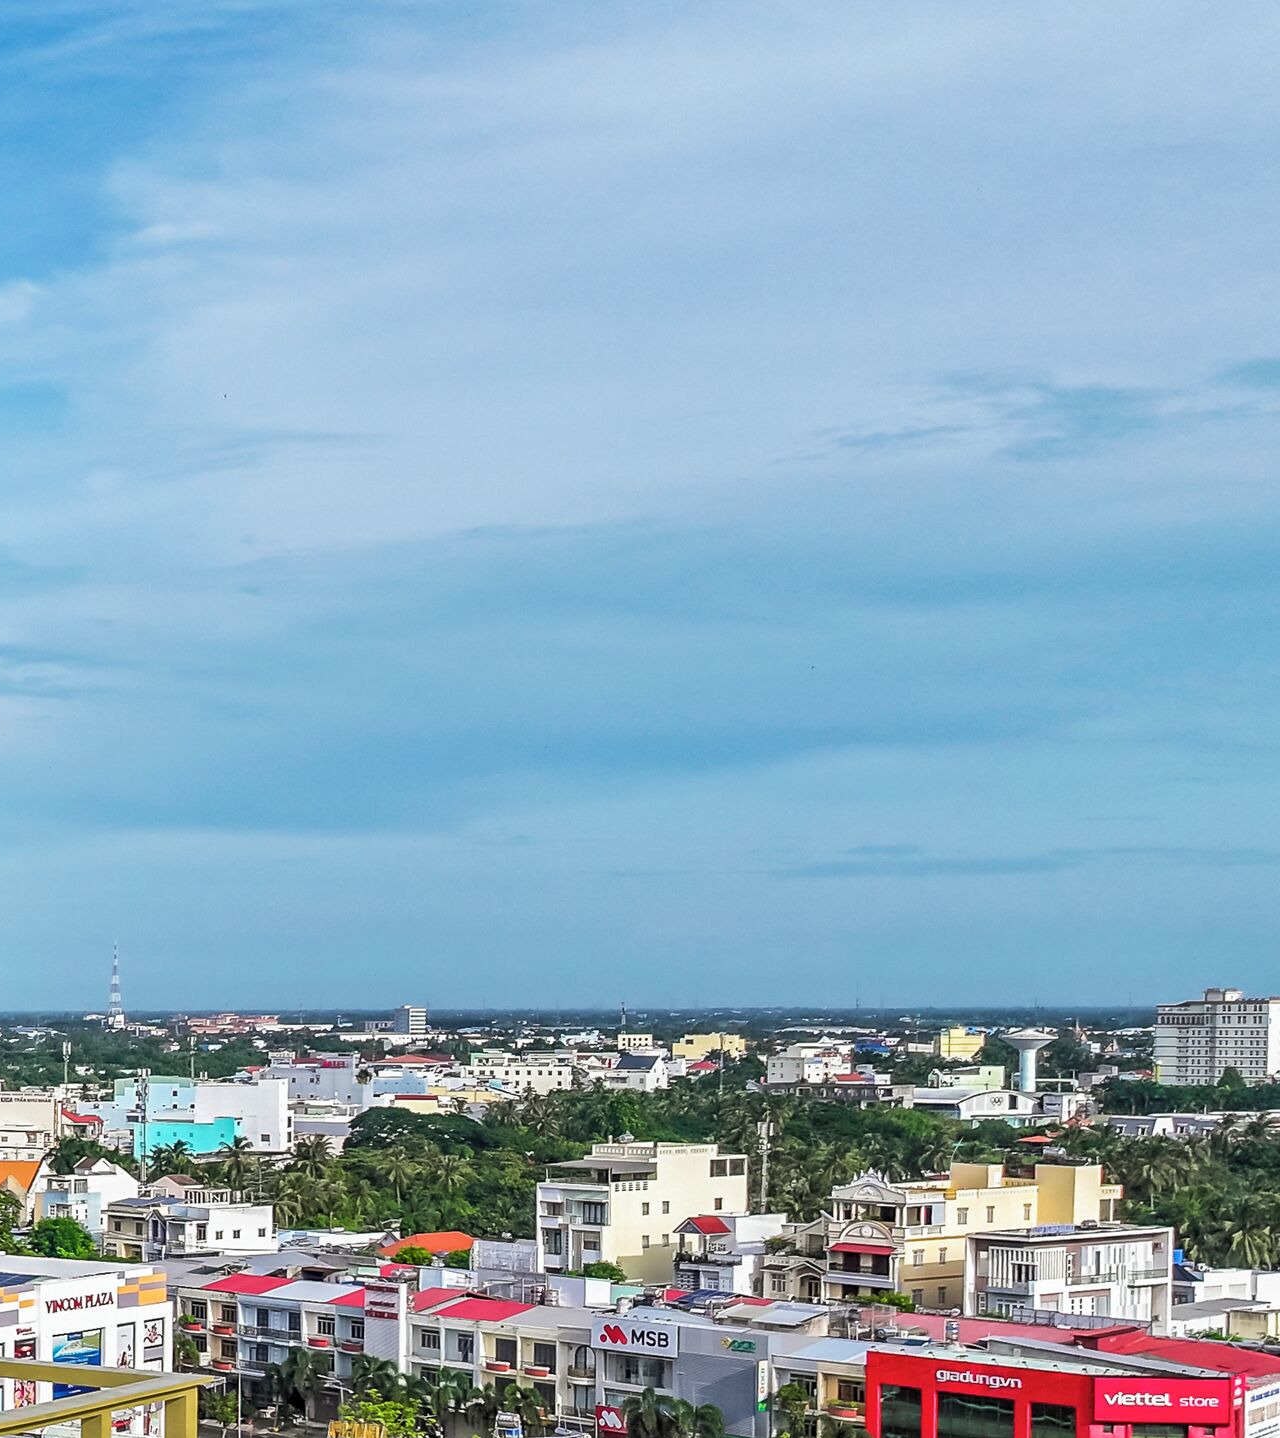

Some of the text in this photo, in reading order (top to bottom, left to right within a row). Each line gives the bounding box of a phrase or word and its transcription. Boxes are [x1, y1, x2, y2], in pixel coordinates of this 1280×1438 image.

[45, 1292, 114, 1314] VINCOM PLAZA
[631, 1328, 669, 1348] MSB
[1104, 1392, 1220, 1408] viettel store
